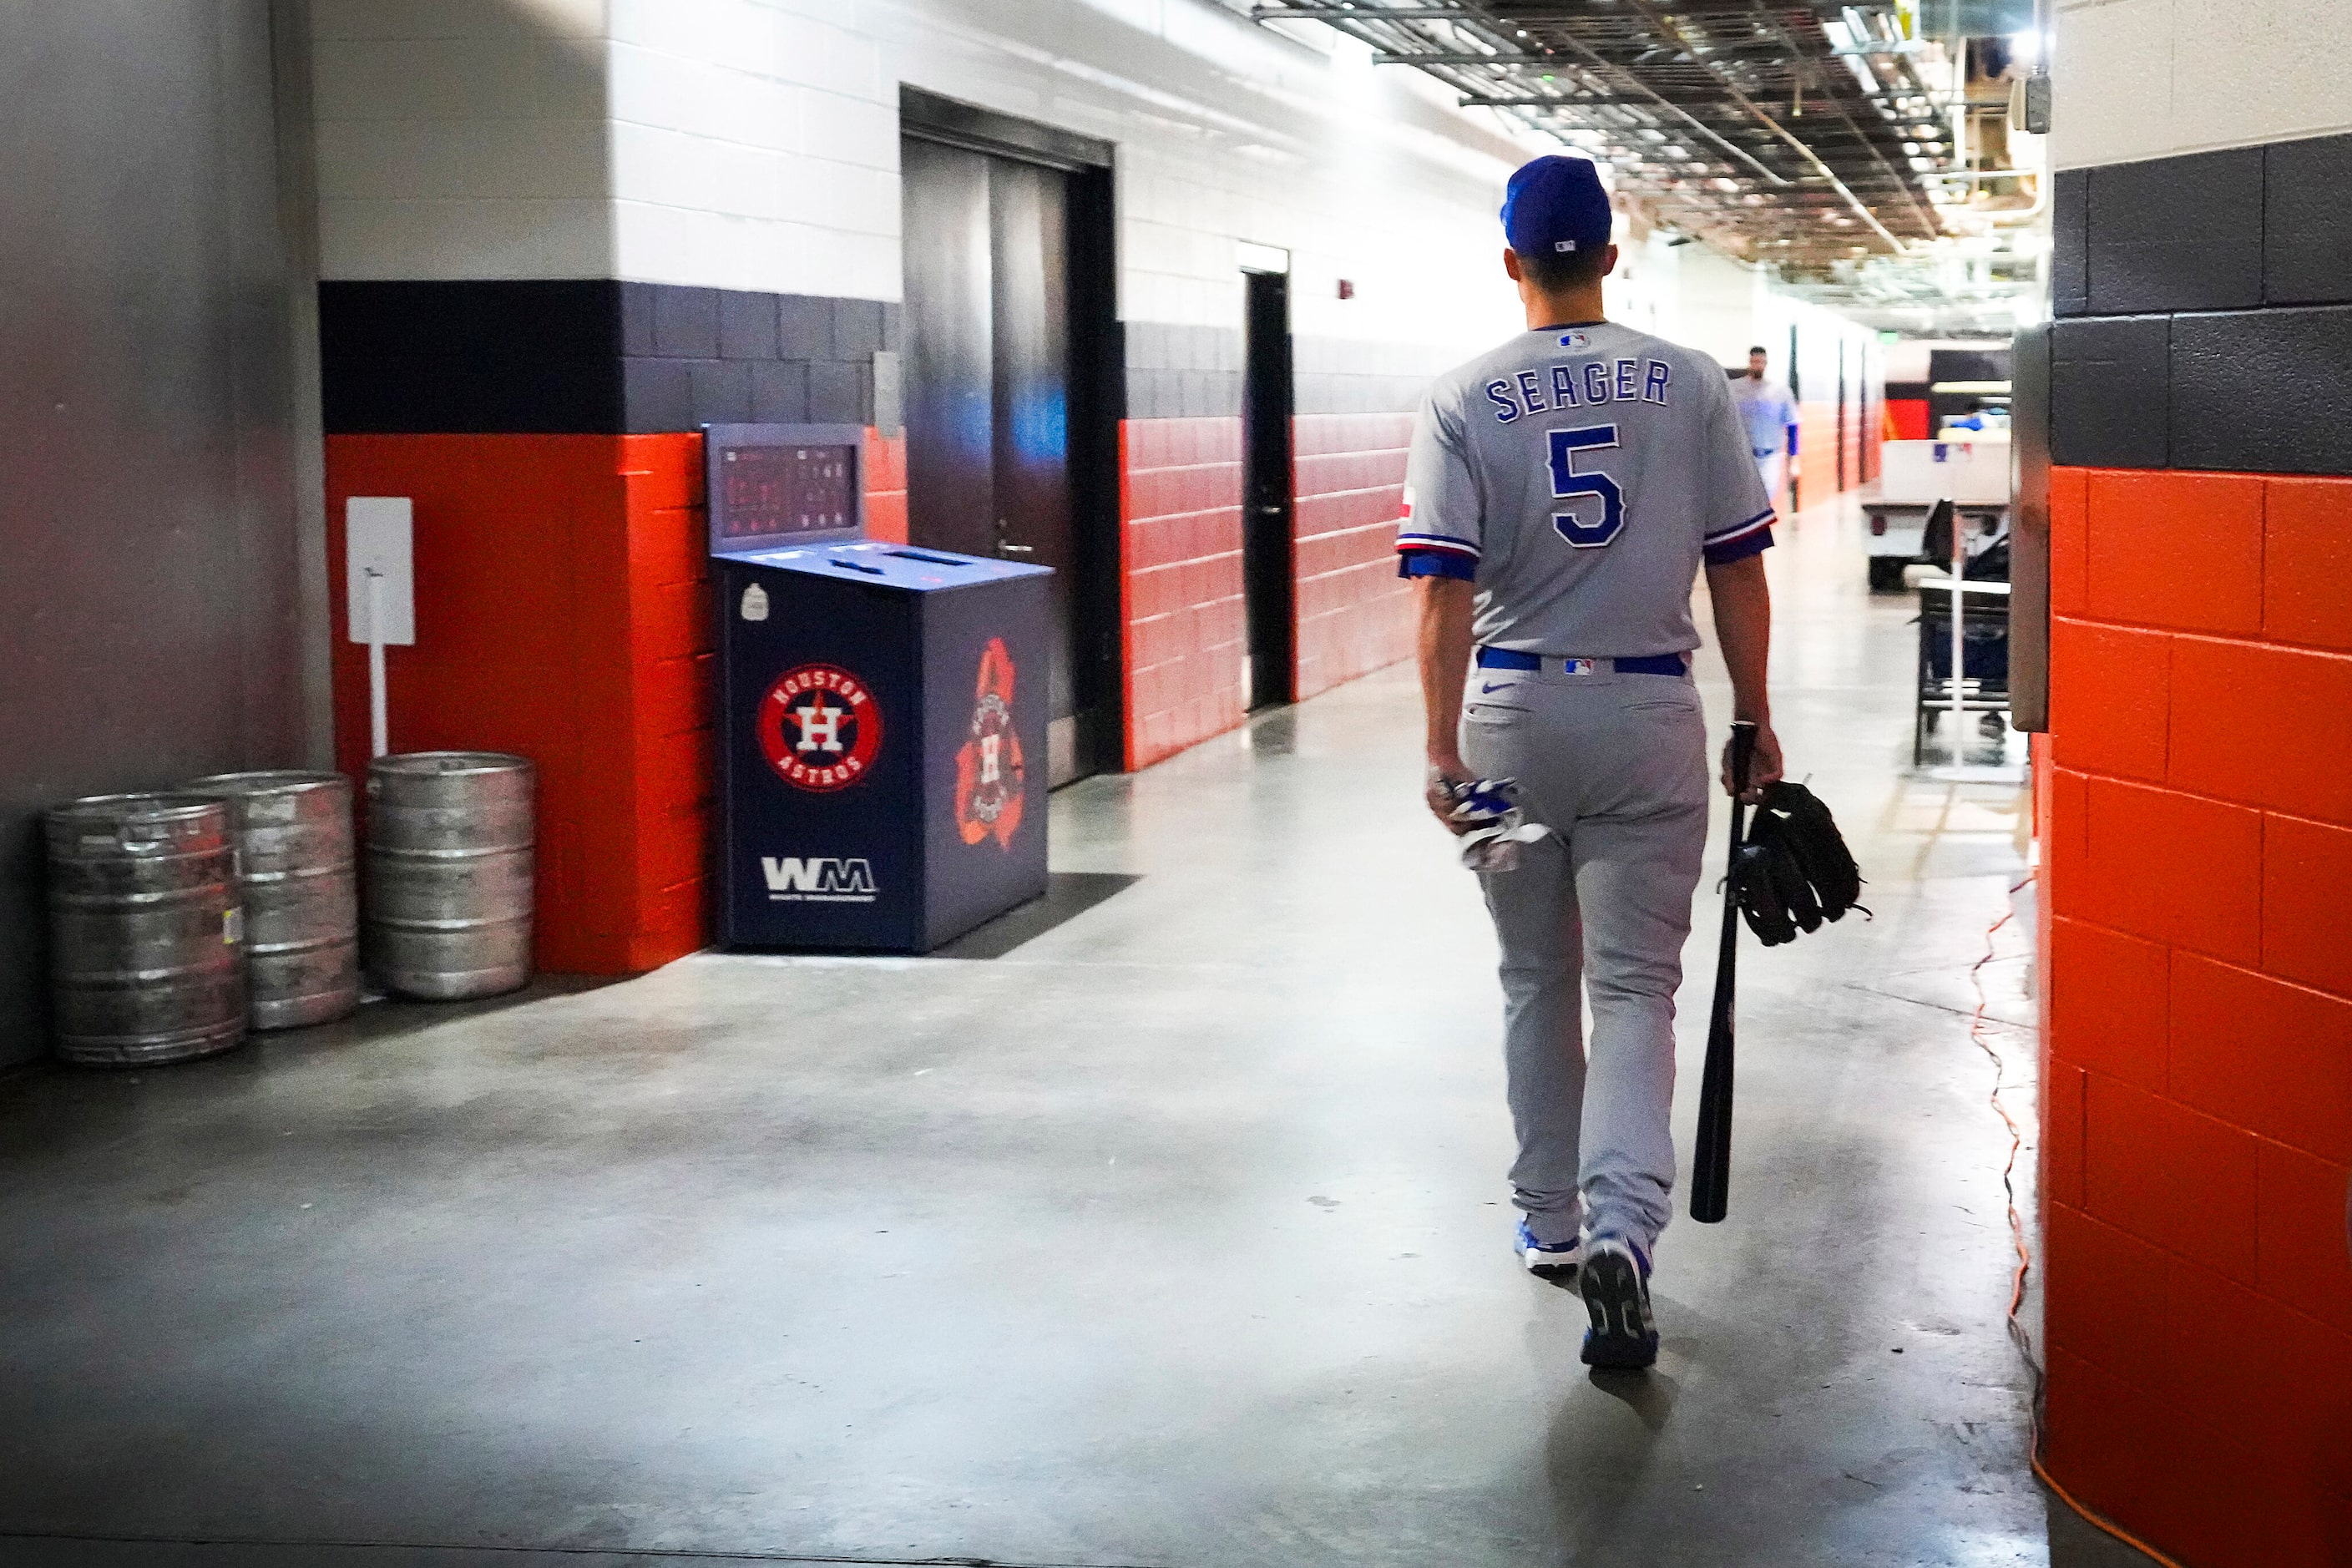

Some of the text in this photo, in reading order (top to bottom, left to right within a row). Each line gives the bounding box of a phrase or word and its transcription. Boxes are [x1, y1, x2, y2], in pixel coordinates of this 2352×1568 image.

[1486, 359, 1671, 424] SEAGER
[1545, 423, 1626, 548] 5
[772, 670, 867, 706] HOUSTON
[796, 706, 843, 751] H
[777, 756, 862, 784] ASTROS
[761, 857, 880, 892] WM
